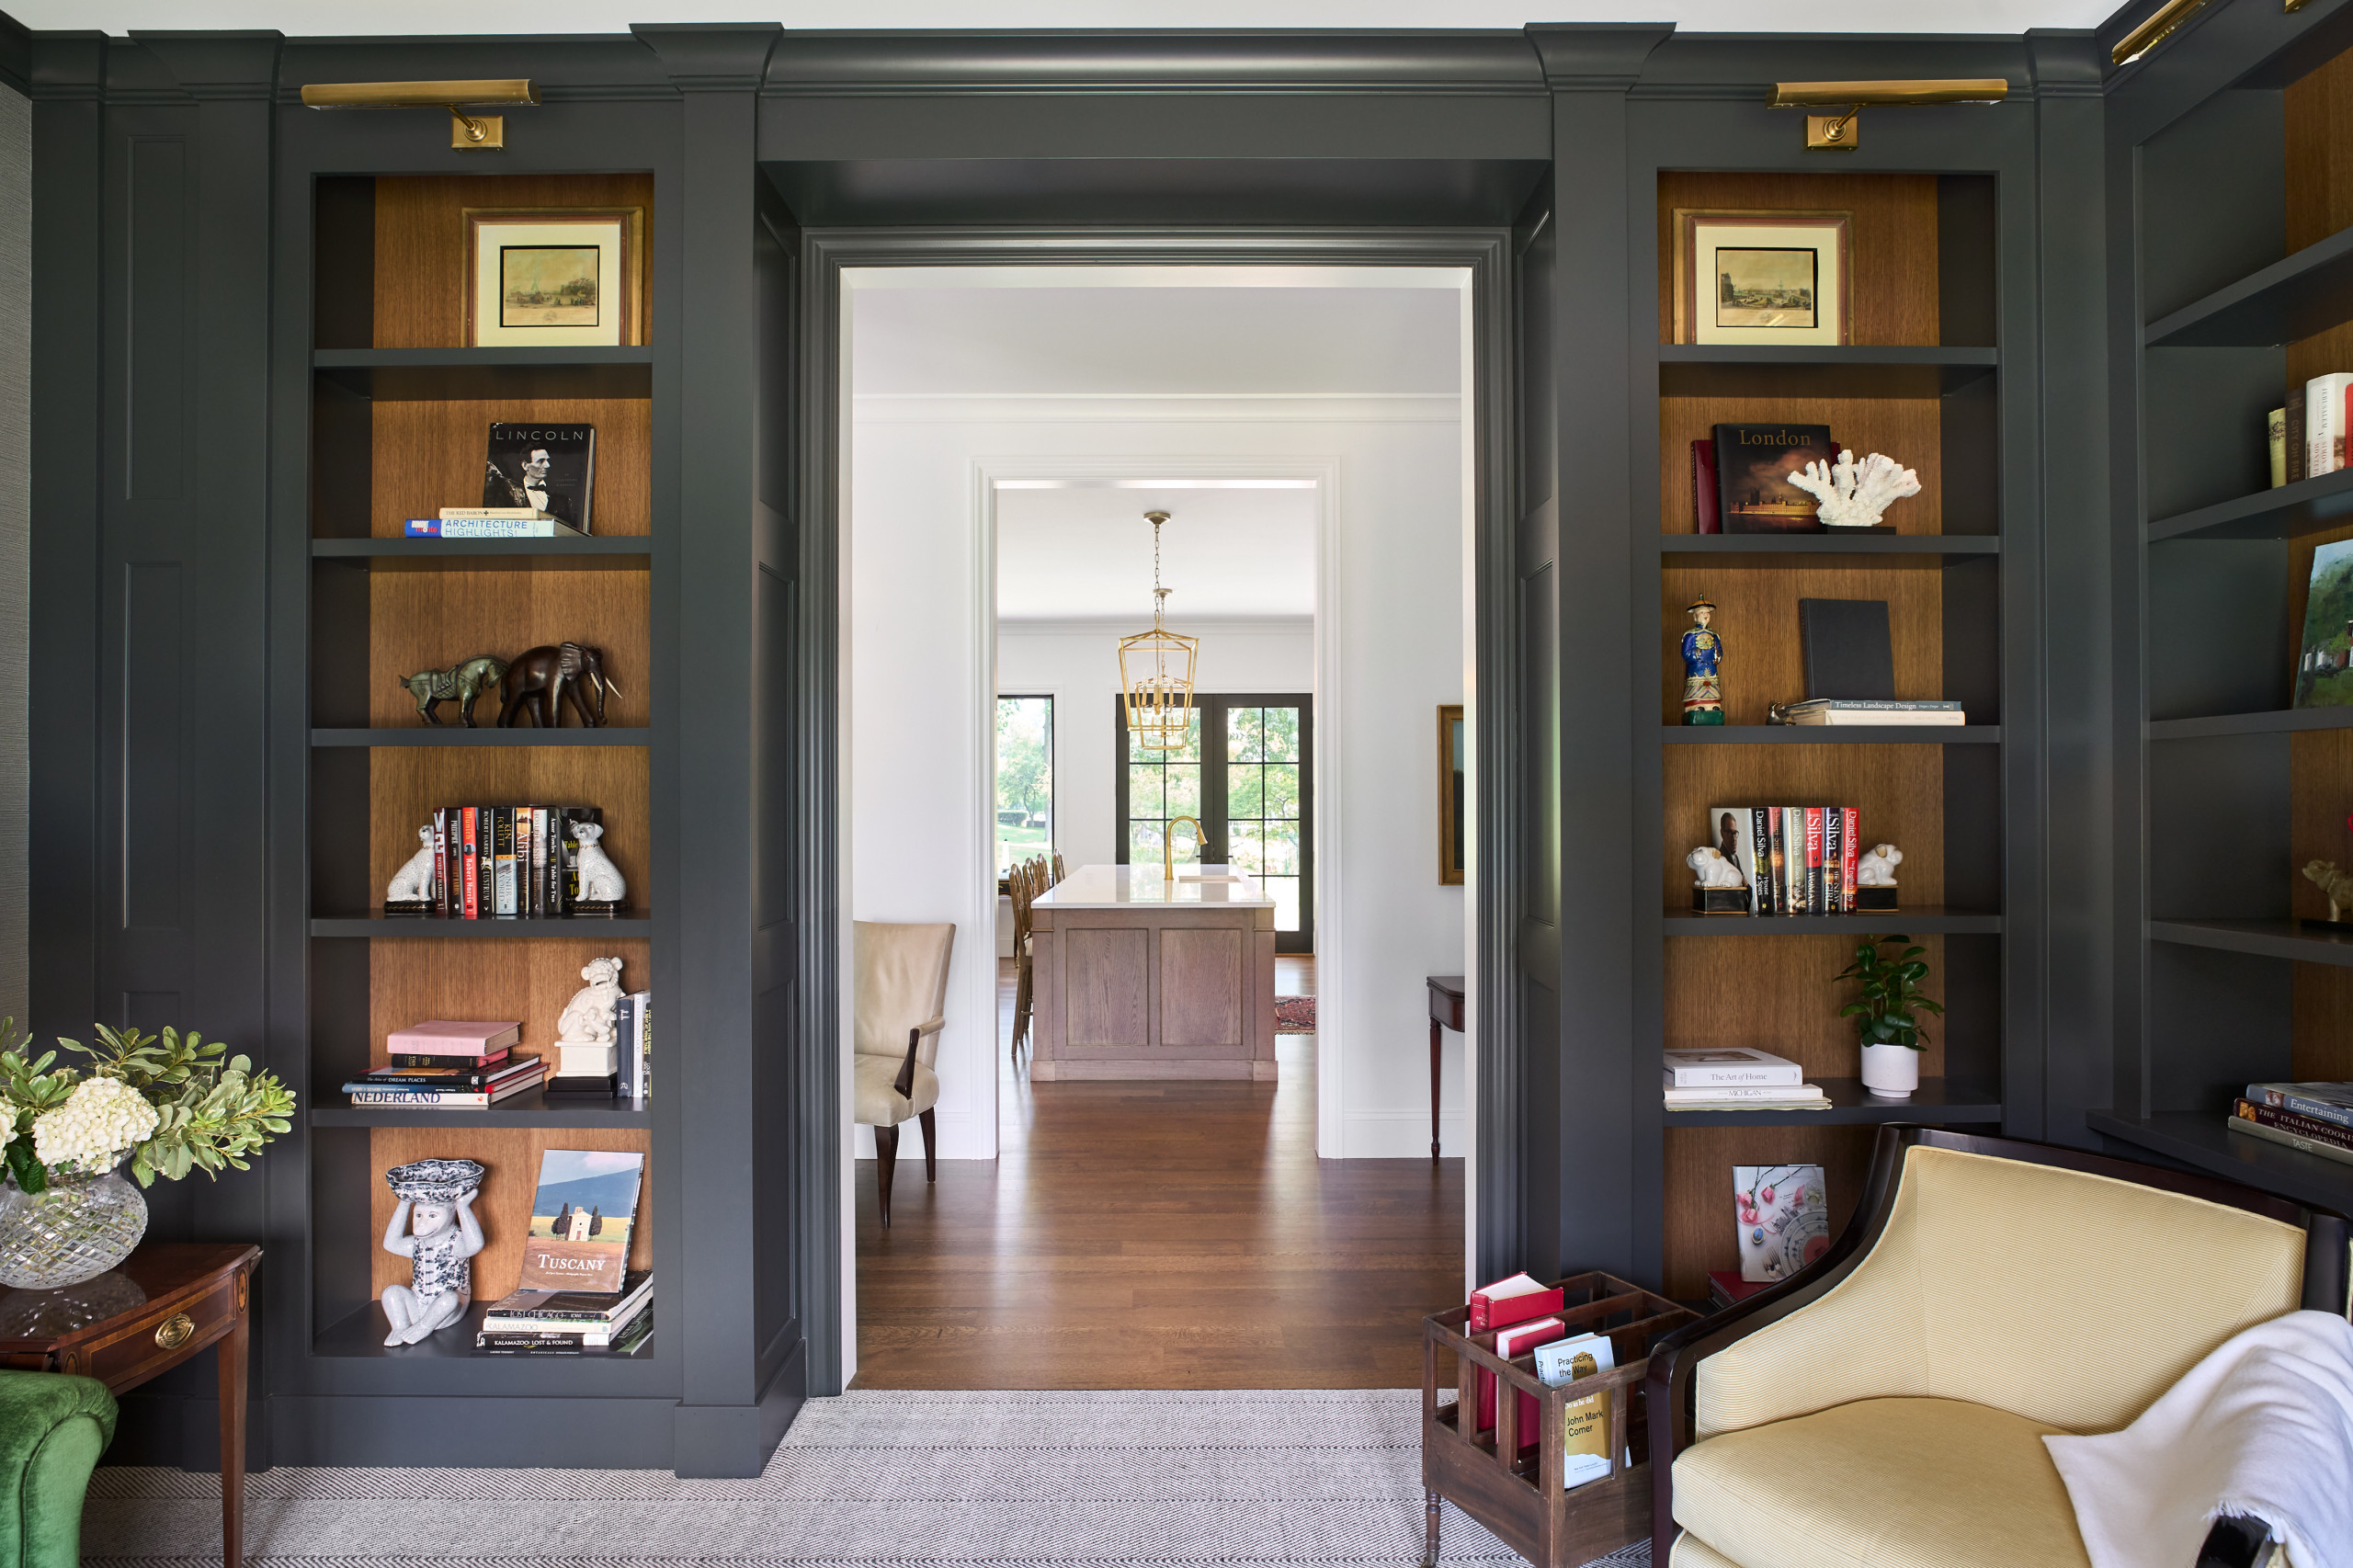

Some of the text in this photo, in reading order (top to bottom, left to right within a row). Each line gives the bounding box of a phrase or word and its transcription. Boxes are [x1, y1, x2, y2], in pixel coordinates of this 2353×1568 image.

[495, 430, 584, 441] LINCOLN
[1739, 429, 1811, 446] London
[2291, 443, 2300, 459] ON
[2290, 460, 2300, 480] FIRE
[445, 519, 528, 528] ARCHITECTURE
[1863, 701, 1894, 710] Landscape
[1895, 702, 1917, 710] Design
[464, 811, 473, 840] Munich
[1792, 809, 1802, 856] Daniel Silva
[1826, 817, 1840, 850] Silva
[1756, 811, 1767, 858] Daniel Silva
[1807, 817, 1822, 851] Silva
[1847, 811, 1857, 858] Daniel Silva
[517, 831, 528, 863] Alibi
[564, 840, 579, 849] Table
[1808, 871, 1816, 906] WOMAN
[1738, 1073, 1746, 1083] of
[353, 1092, 441, 1103] NEDERLAND
[2290, 1098, 2349, 1124] Entertaining
[2258, 1108, 2276, 1119] THE
[2280, 1115, 2319, 1131] ITALIAN
[2274, 1121, 2348, 1149] ENCYCLOPEDIA
[2292, 1139, 2313, 1152] TASTE
[1557, 1353, 1593, 1367] Practicing
[1559, 1364, 1587, 1378] the Way
[1586, 1395, 1595, 1403] did
[1566, 1410, 1604, 1426] John Mark
[1568, 1425, 1593, 1437] Comer
